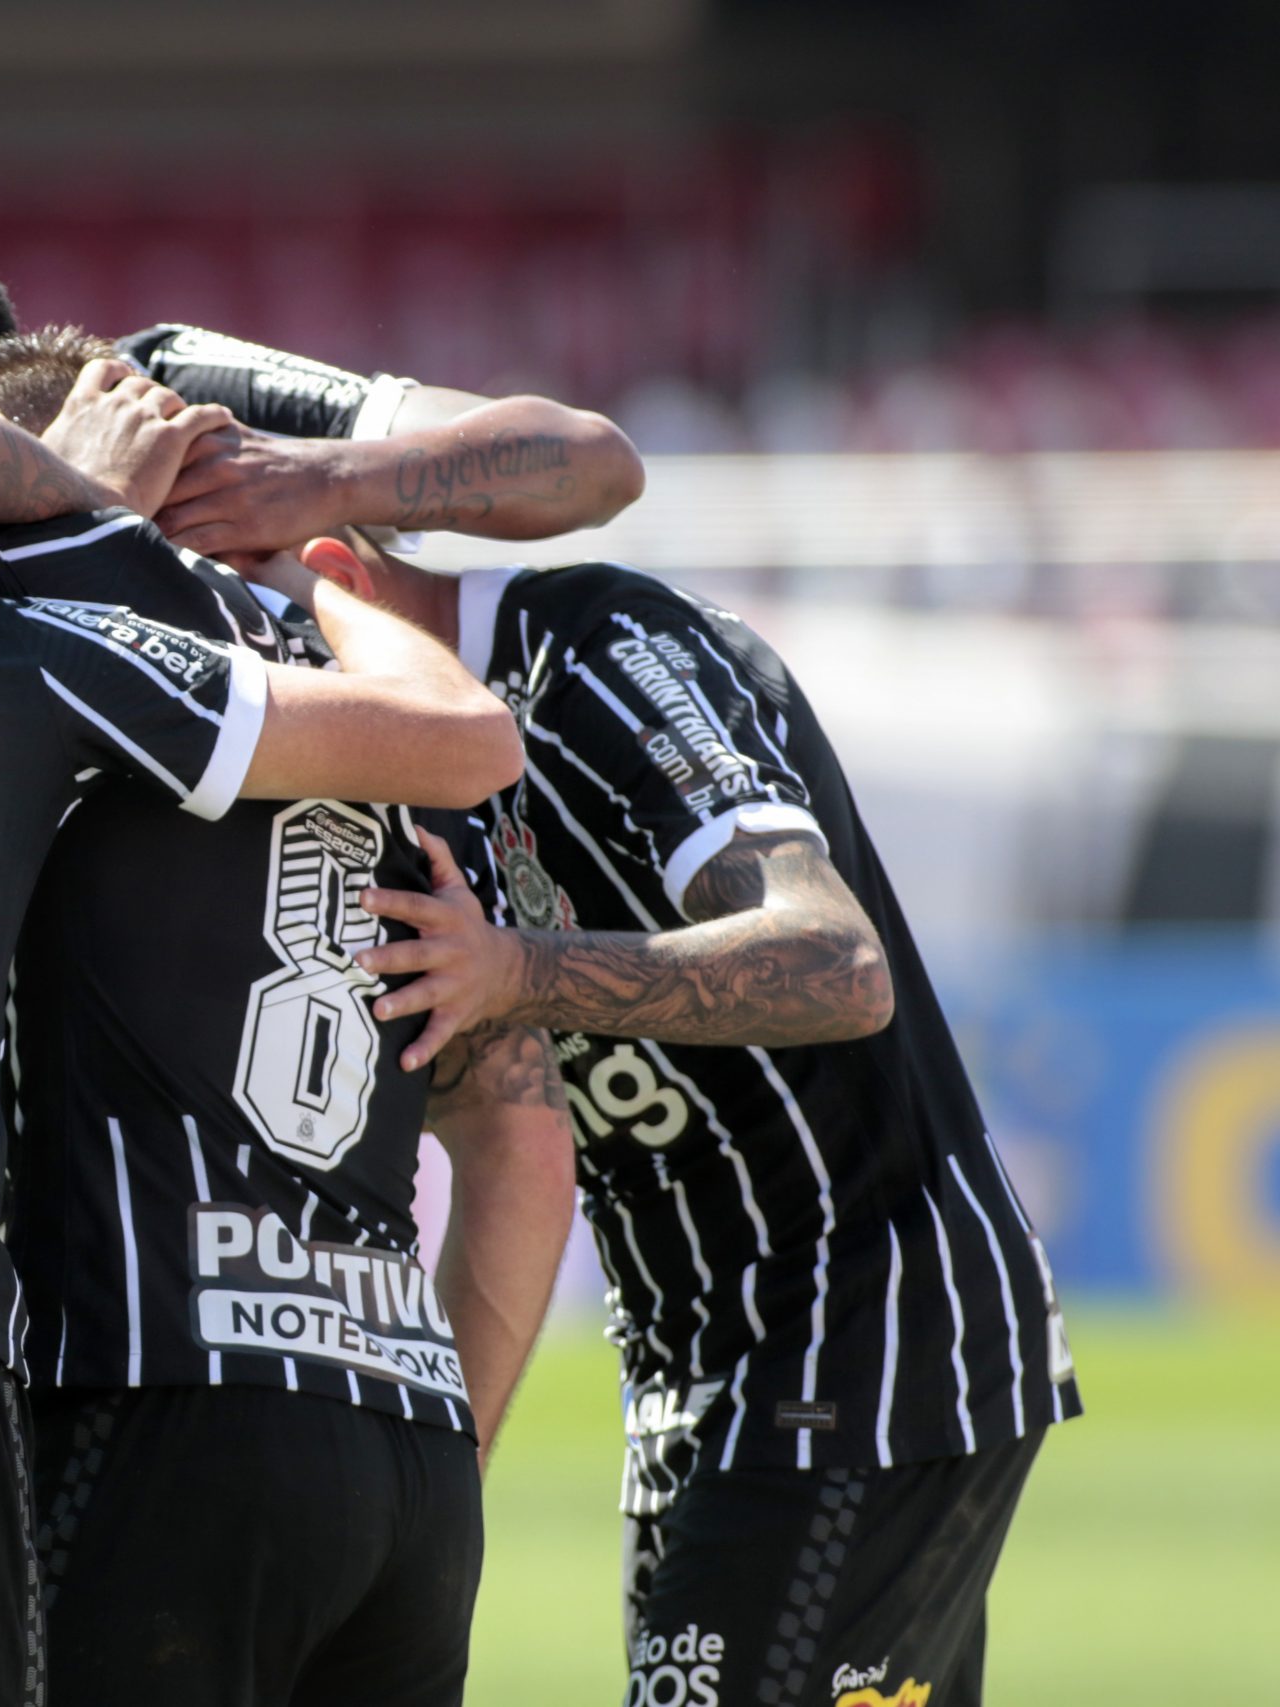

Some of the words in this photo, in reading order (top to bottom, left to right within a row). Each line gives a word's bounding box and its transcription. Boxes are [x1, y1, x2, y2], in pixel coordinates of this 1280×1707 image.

[127, 619, 189, 650] powered
[189, 648, 207, 663] by
[608, 637, 754, 798] CORINTHIANS
[304, 817, 371, 865] PES2021
[232, 798, 389, 1172] 8
[670, 1622, 725, 1664] de
